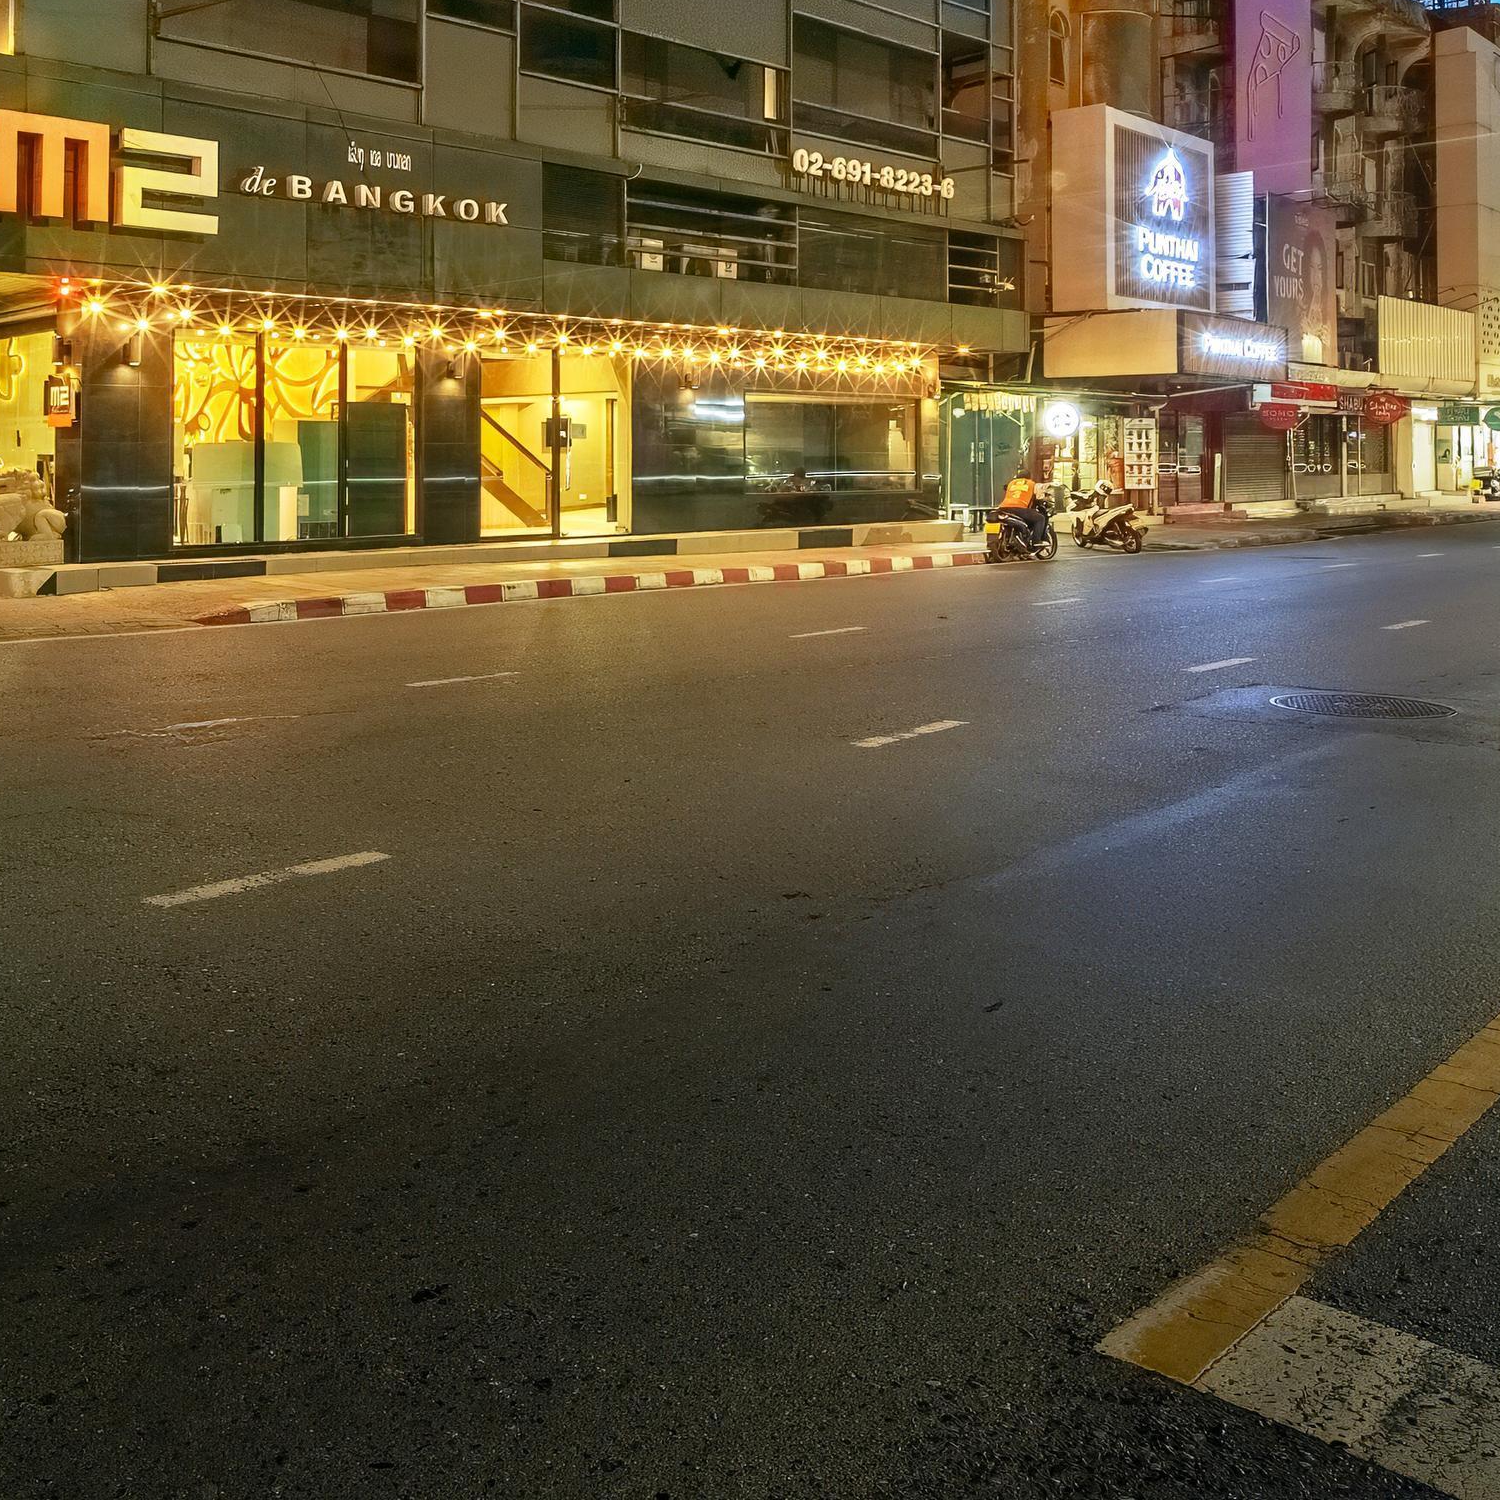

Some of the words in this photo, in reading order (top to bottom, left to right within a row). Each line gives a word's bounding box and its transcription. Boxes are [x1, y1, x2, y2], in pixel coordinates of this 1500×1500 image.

[792, 148, 955, 199] 02-691-8223-6
[240, 166, 277, 196] de
[286, 174, 510, 226] BANGKOK
[1138, 224, 1199, 262] PUNTHAI
[1282, 243, 1304, 276] GET
[1140, 253, 1196, 287] COFFEE
[1273, 275, 1305, 300] YOURS
[1339, 395, 1364, 411] SHABU
